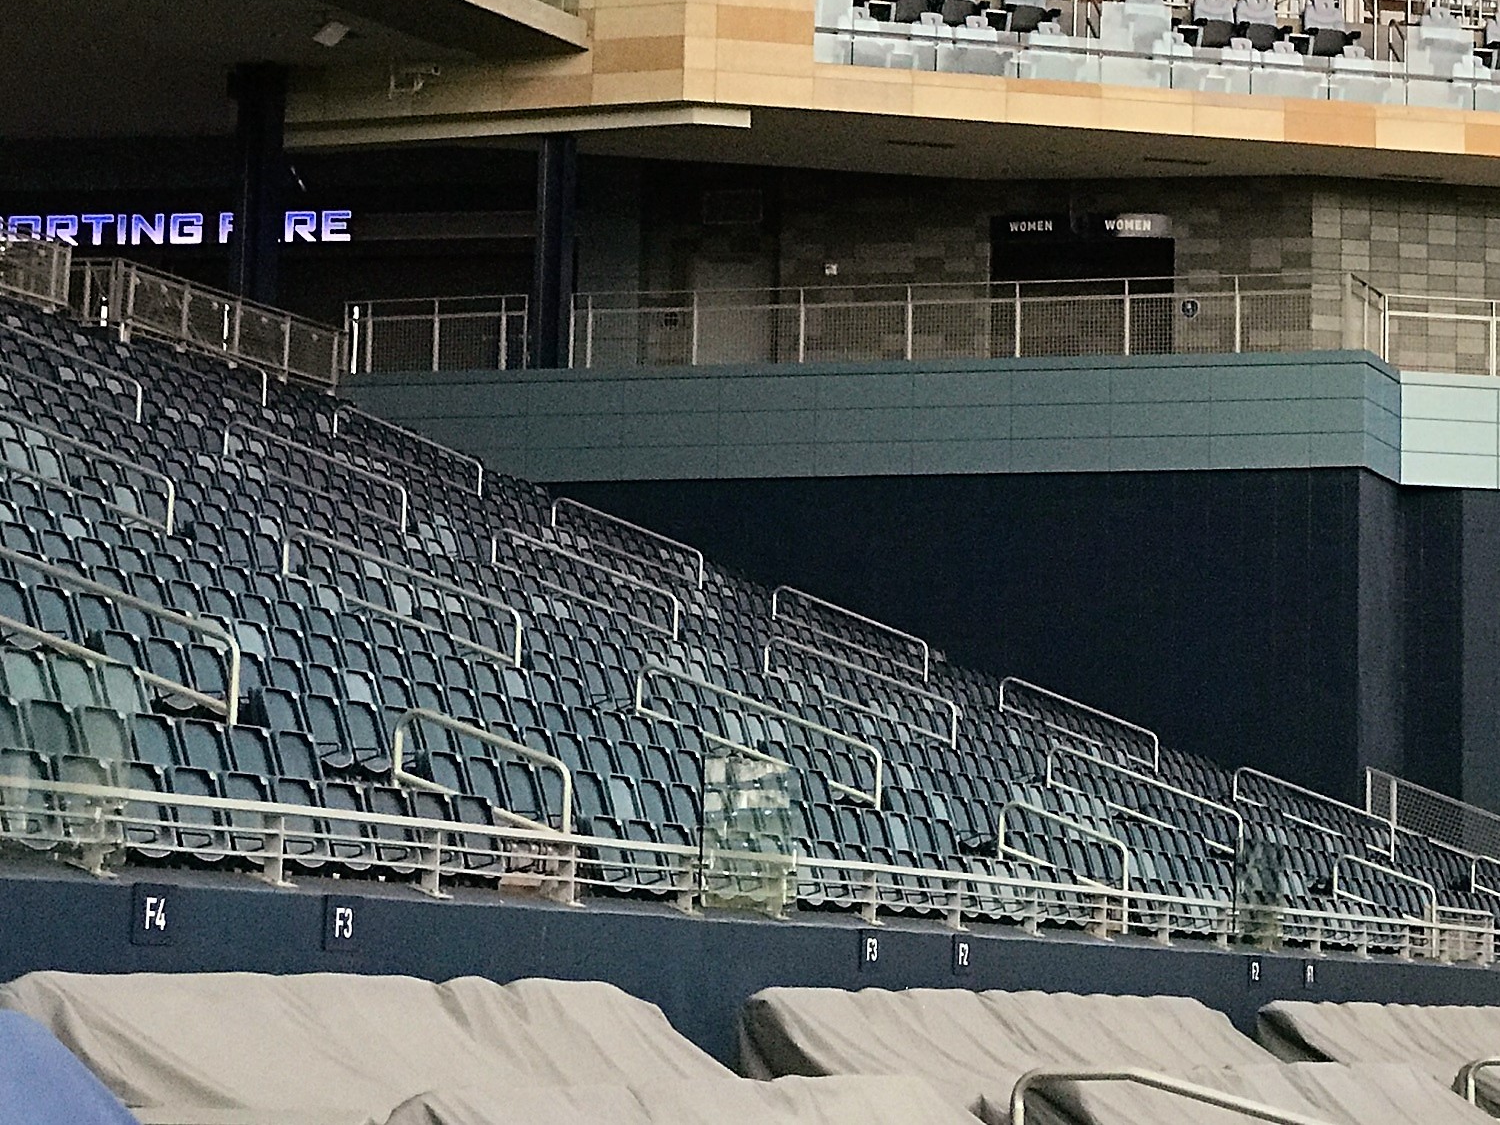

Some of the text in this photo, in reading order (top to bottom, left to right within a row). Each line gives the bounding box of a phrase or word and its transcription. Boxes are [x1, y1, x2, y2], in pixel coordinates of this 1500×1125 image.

[0, 212, 205, 246] ORTING
[1009, 220, 1053, 232] WOMEN
[1104, 219, 1152, 232] WOMEN
[144, 896, 166, 931] F4
[334, 906, 353, 939] F3
[866, 937, 878, 962] F3
